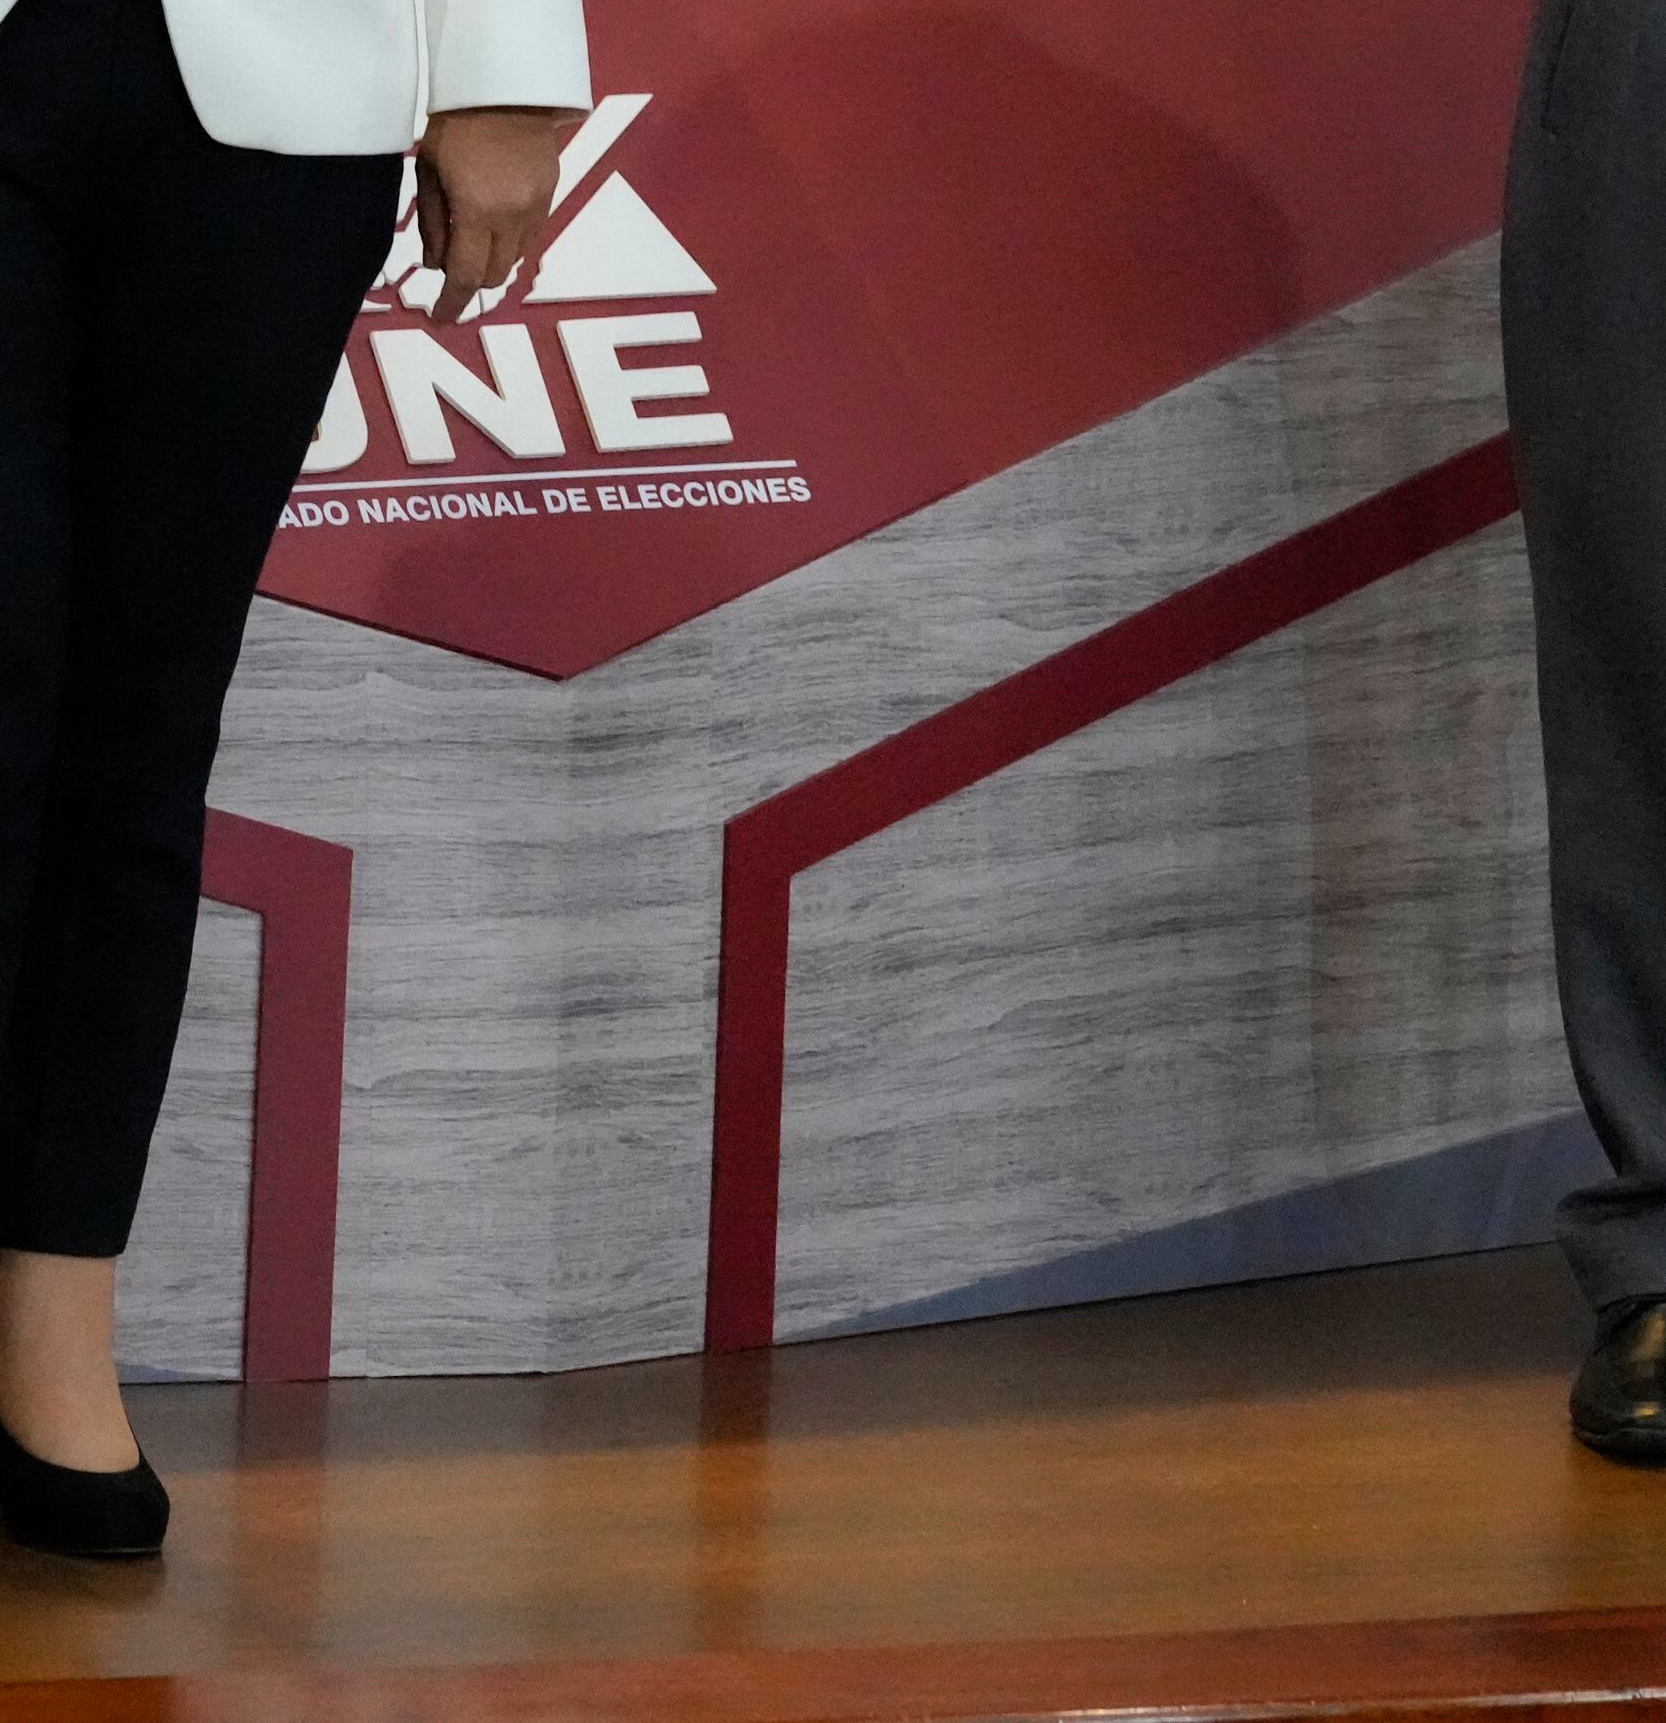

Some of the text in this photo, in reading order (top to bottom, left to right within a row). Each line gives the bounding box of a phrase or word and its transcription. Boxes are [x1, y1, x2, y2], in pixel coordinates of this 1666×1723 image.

[277, 476, 812, 529] ADO NACIONAL DE ELECCIONES
